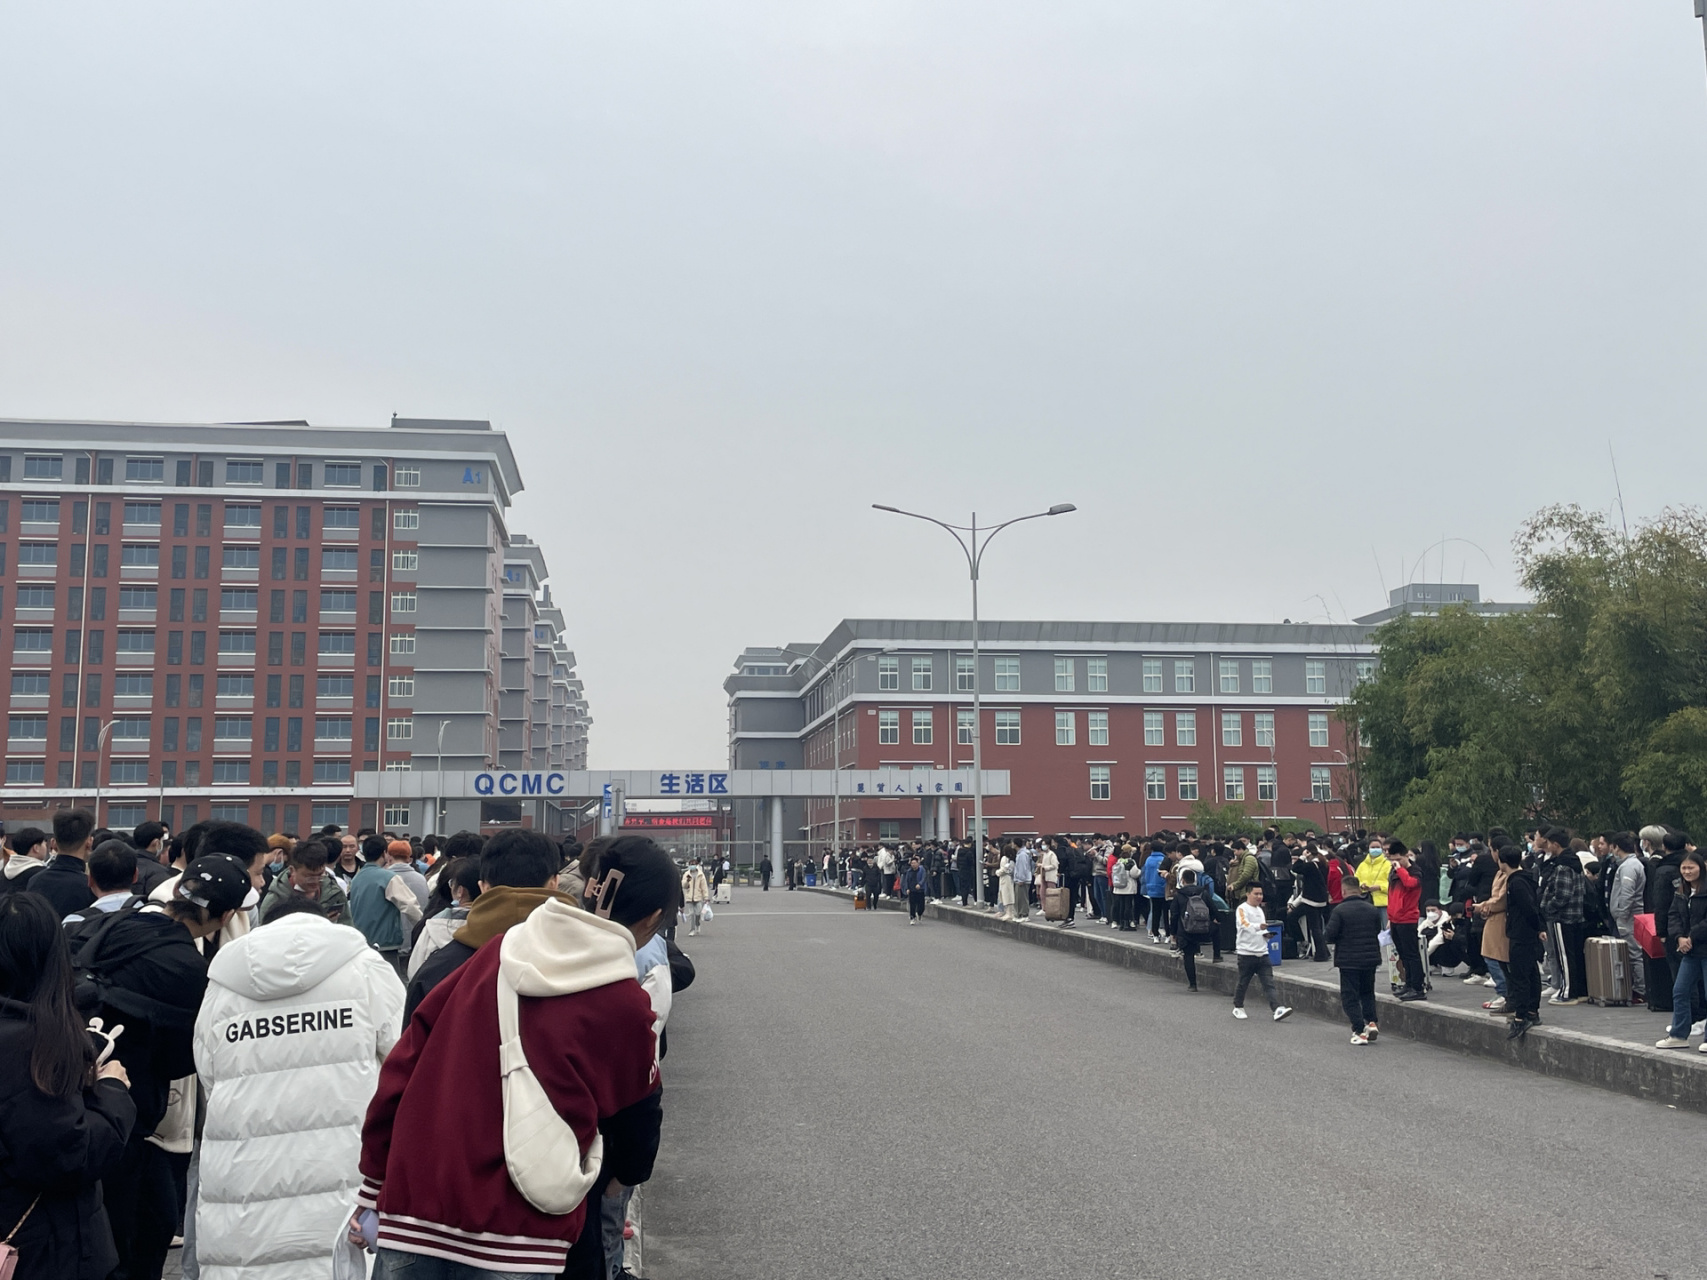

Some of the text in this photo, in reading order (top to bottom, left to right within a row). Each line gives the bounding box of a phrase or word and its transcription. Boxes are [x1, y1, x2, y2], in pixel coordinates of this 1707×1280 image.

[462, 467, 481, 484] A1
[474, 773, 565, 795] QCMC
[660, 773, 729, 794] 生活区
[225, 1007, 353, 1043] GABSERINE
